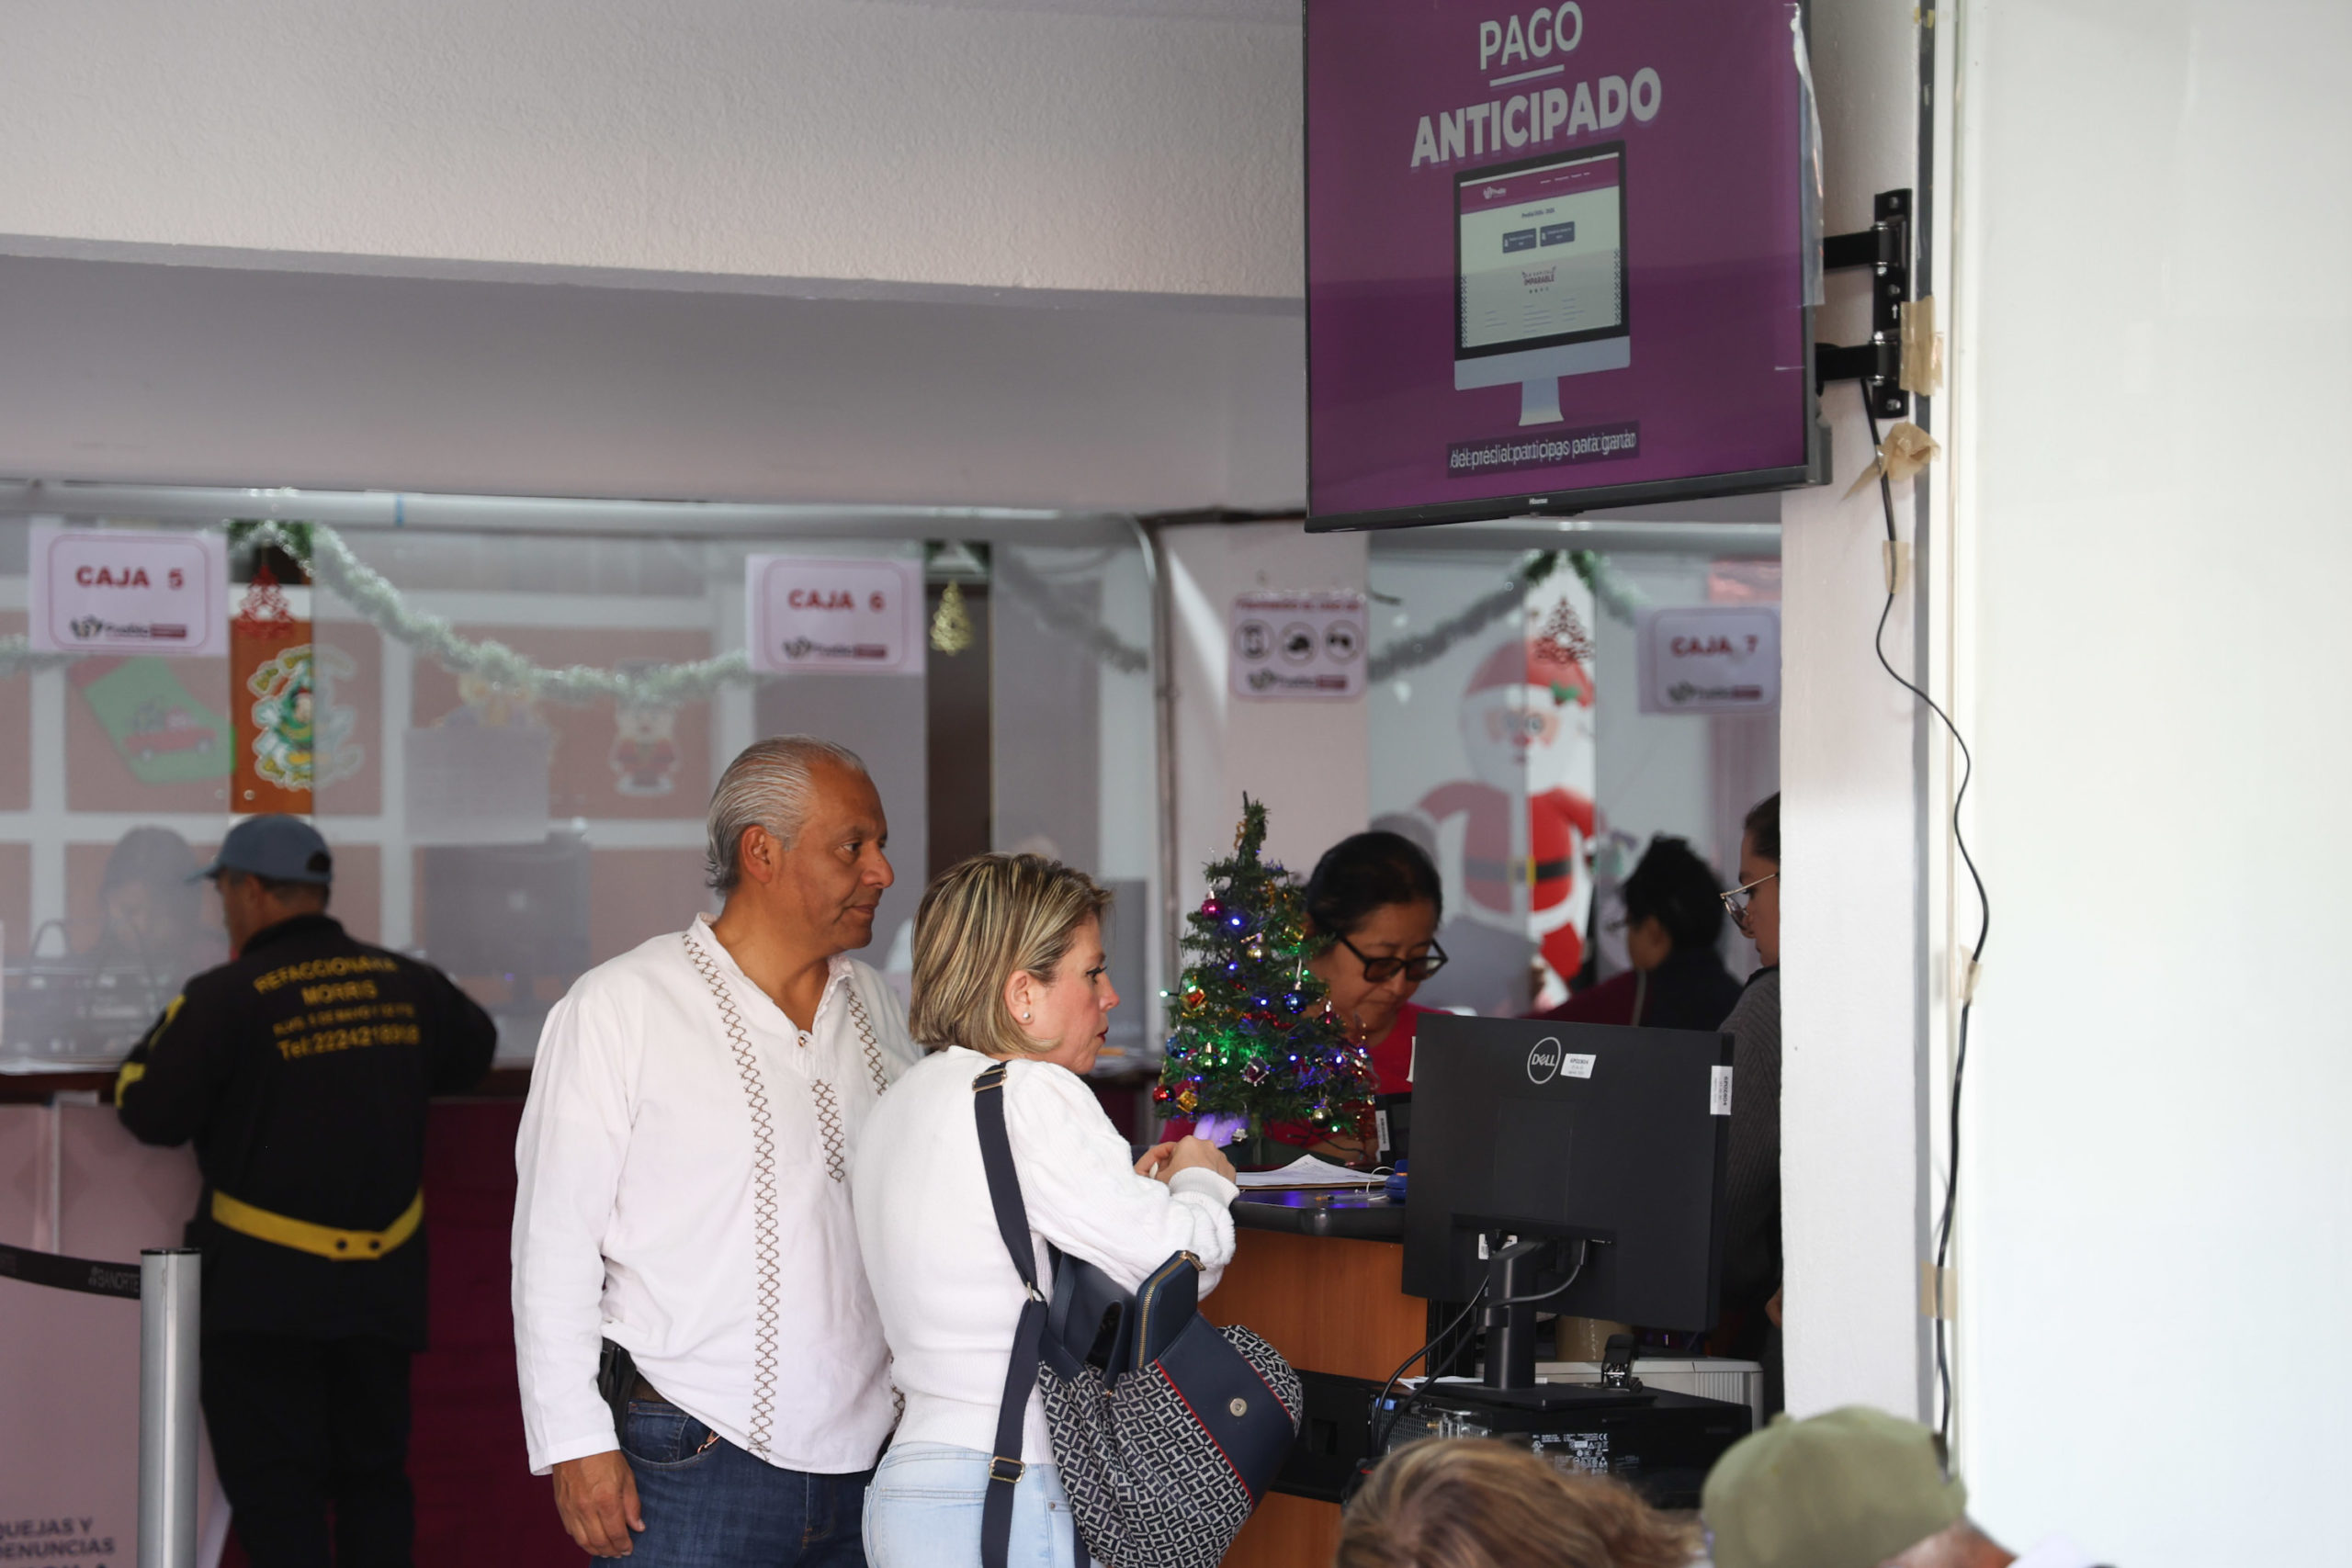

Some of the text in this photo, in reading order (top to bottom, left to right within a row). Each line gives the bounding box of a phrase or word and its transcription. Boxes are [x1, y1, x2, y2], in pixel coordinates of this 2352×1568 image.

[1480, 1, 1583, 70] PAGO
[1410, 67, 1662, 167] ANTICIPADO
[75, 565, 184, 589] CAJA 5
[788, 589, 886, 612] CAJA 6
[1670, 634, 1759, 657] CAJA 7
[301, 979, 379, 1006] MORRIS
[1532, 1053, 1555, 1066] DELL
[0, 1516, 93, 1540] UEJAS Y
[0, 1537, 115, 1559] ENUNCIAS
